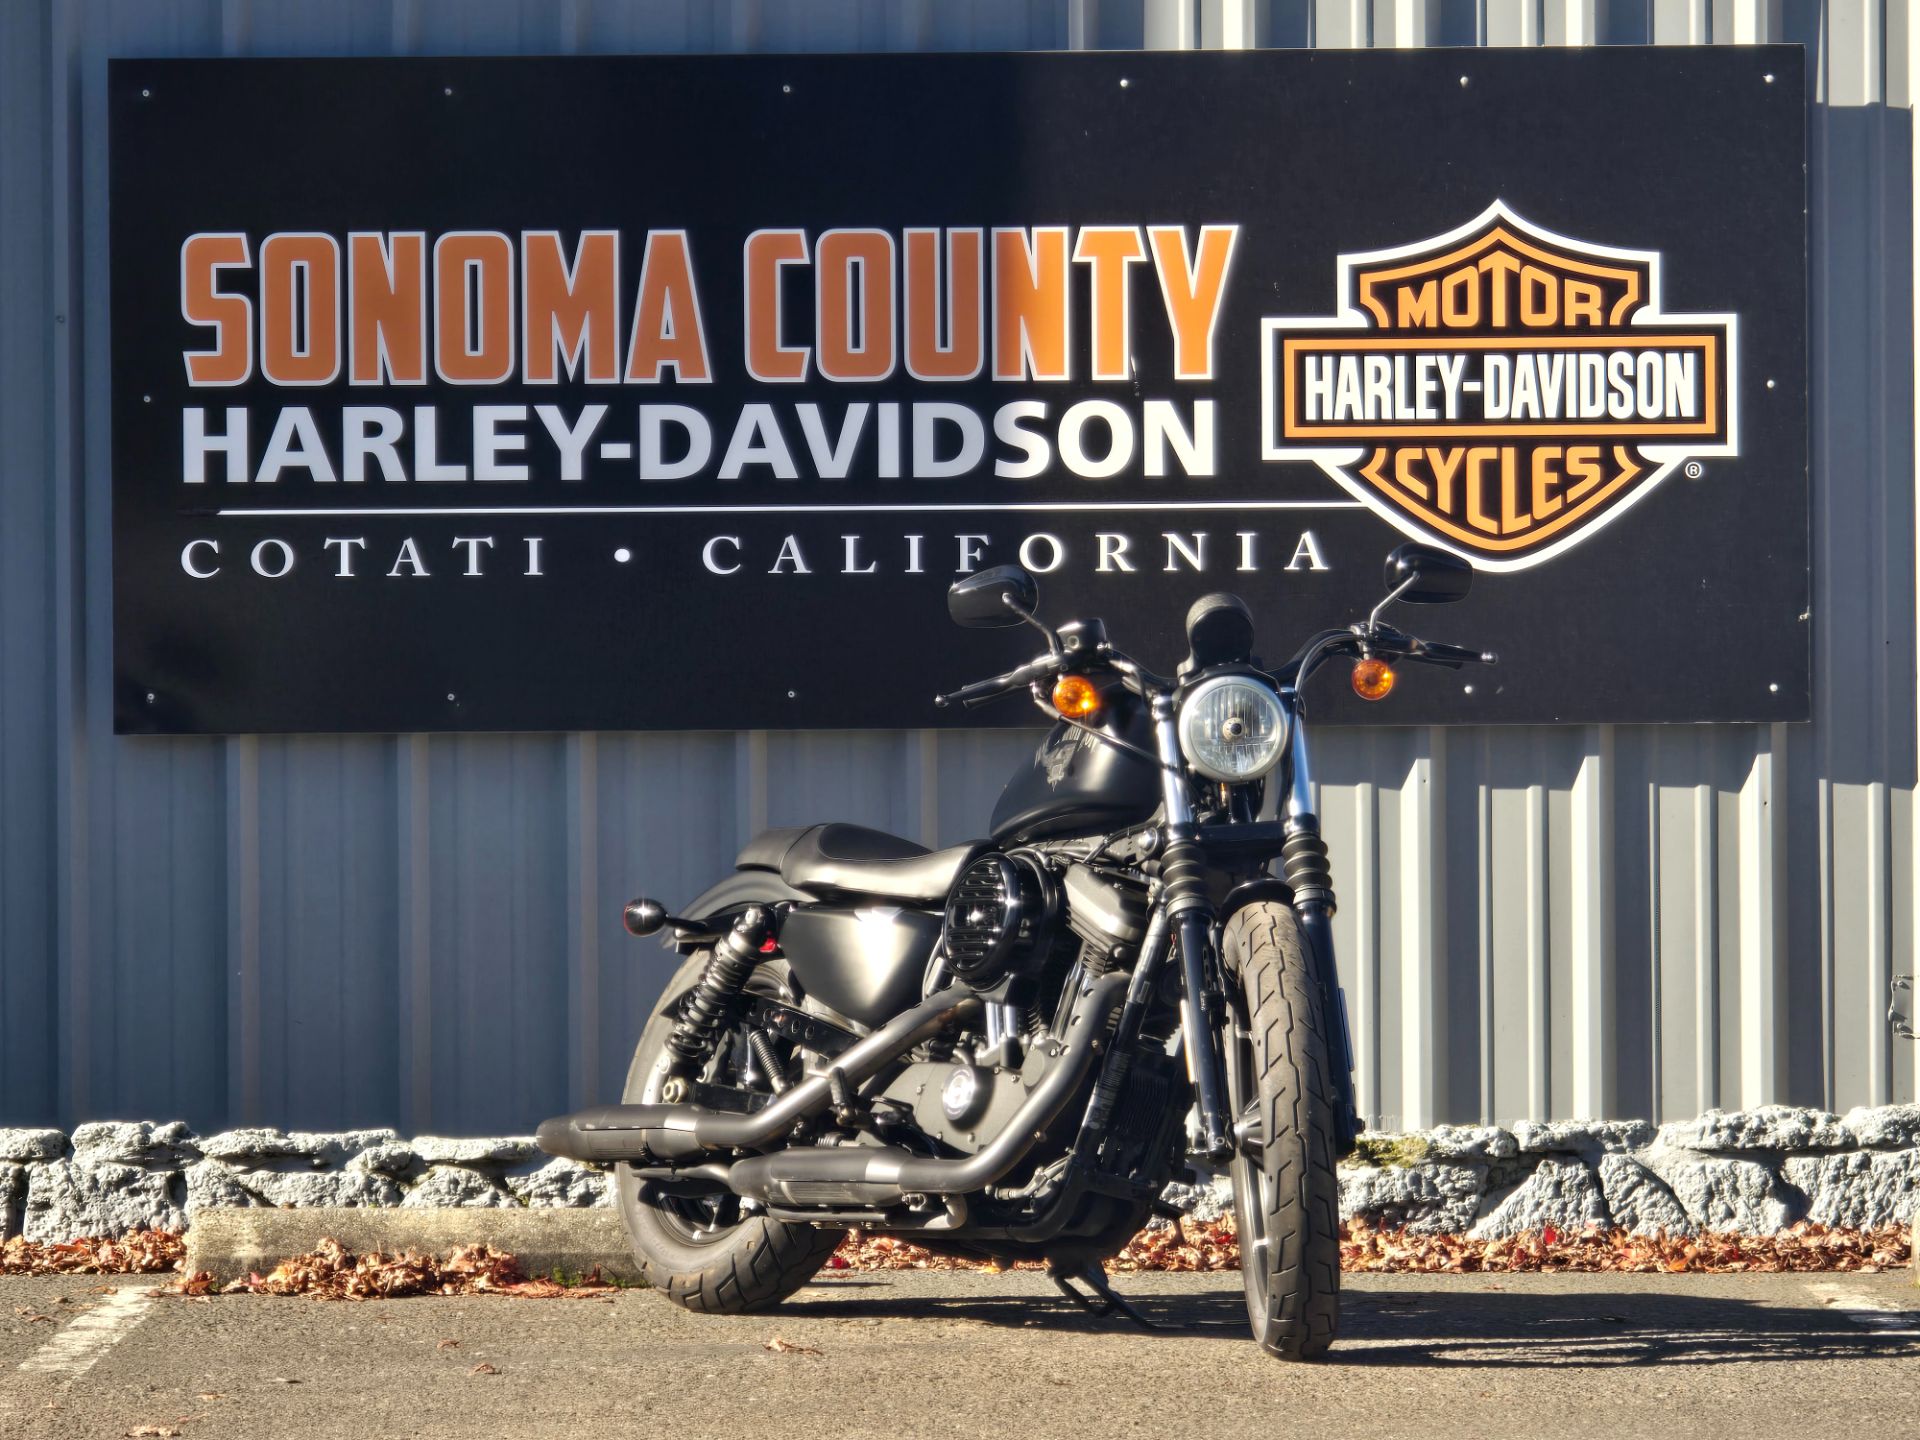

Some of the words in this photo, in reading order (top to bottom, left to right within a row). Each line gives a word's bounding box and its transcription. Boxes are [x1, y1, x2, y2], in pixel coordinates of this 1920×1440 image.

[181, 230, 712, 386] SONOMA
[743, 226, 1238, 382] COUNTY
[1397, 250, 1602, 328] MOTOR
[1305, 351, 1695, 420] HARLEY-DAVIDSON
[182, 400, 1215, 483] HARLEY-DAVIDSON
[1395, 446, 1601, 535] CYCLES
[181, 537, 544, 578] COTATI
[702, 531, 1329, 575] CALIFORNIA
